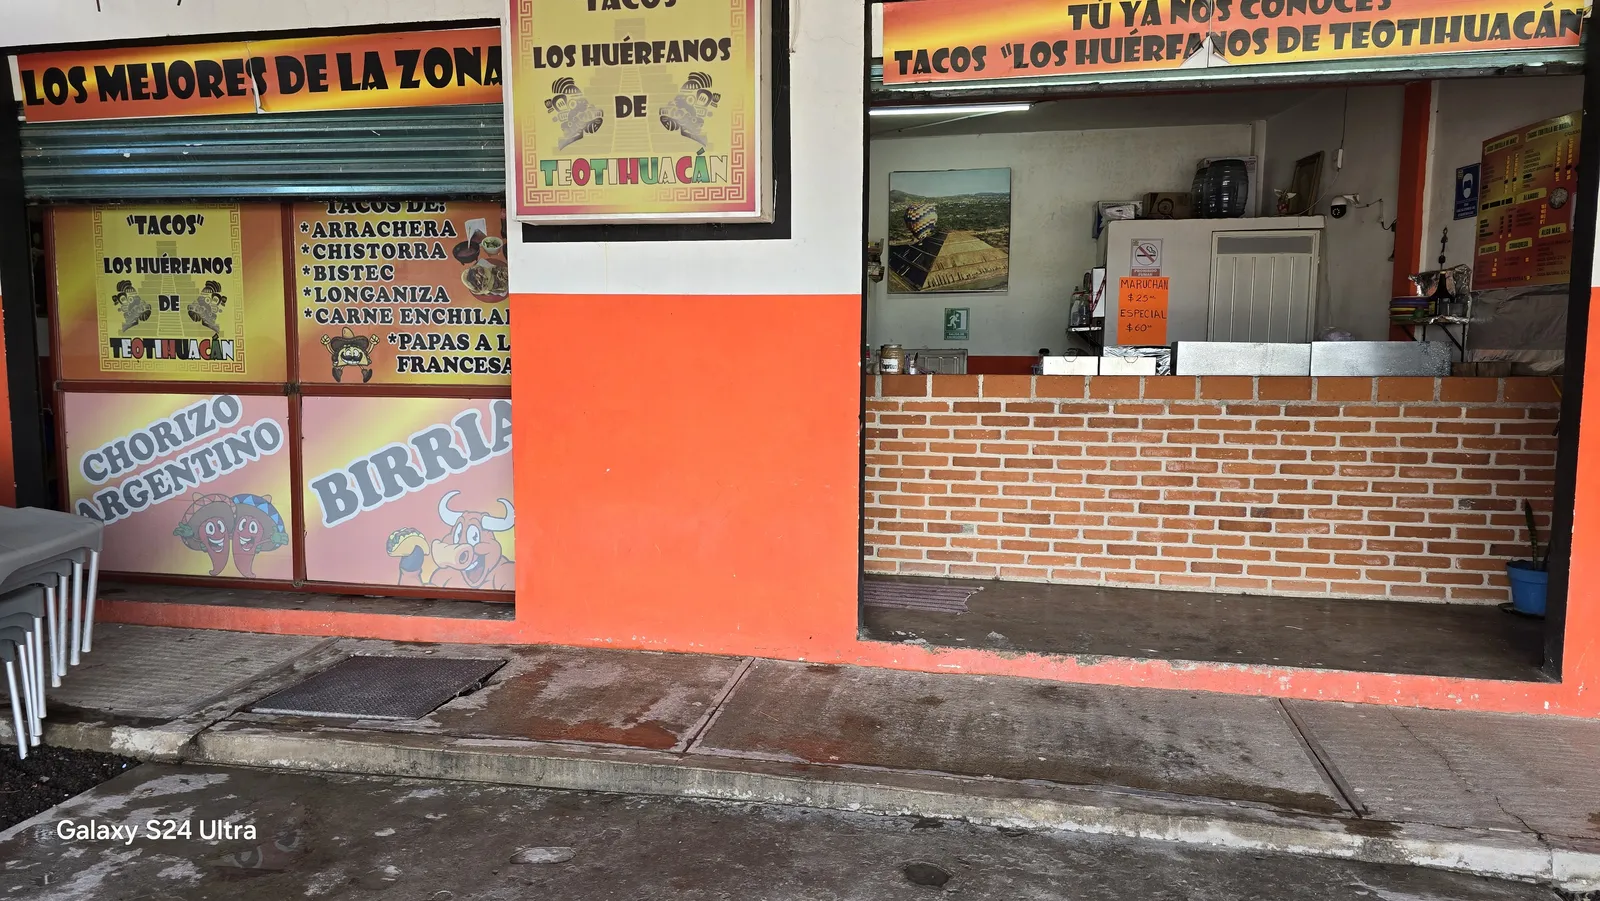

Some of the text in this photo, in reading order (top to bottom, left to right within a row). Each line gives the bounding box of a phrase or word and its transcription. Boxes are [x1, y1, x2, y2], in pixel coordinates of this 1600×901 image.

[1119, 0, 1162, 27] YA
[1170, 0, 1233, 25] NOS
[894, 45, 987, 75] TACOS
[1277, 24, 1321, 53] DE
[1329, 1, 1583, 50] TEOTIHUACÁN
[532, 36, 732, 69] LOS HUÉRFANOS
[21, 45, 503, 106] LOS MEJORES DE LA ZONA
[614, 95, 648, 119] DE
[539, 148, 729, 187] TEOTIHUACÁN
[311, 220, 457, 238] ARRACHERA
[312, 242, 448, 260] CHISTORRA
[104, 253, 233, 275] LOS HUÉRFANOS
[313, 264, 394, 282] BISTEC
[1120, 279, 1169, 290] MARUCHAN
[158, 294, 179, 312] DE
[314, 286, 450, 304] LONGANIZA
[315, 307, 509, 325] CARNE ENCHILA
[1120, 309, 1168, 320] ESPECIAL
[109, 334, 235, 361] TEOTIHUACÁN
[398, 333, 470, 351] PAPAS
[475, 333, 492, 351] A
[397, 356, 511, 374] FRANCESA
[82, 394, 239, 480] CHORIZO
[78, 421, 281, 521] ARGENTINO
